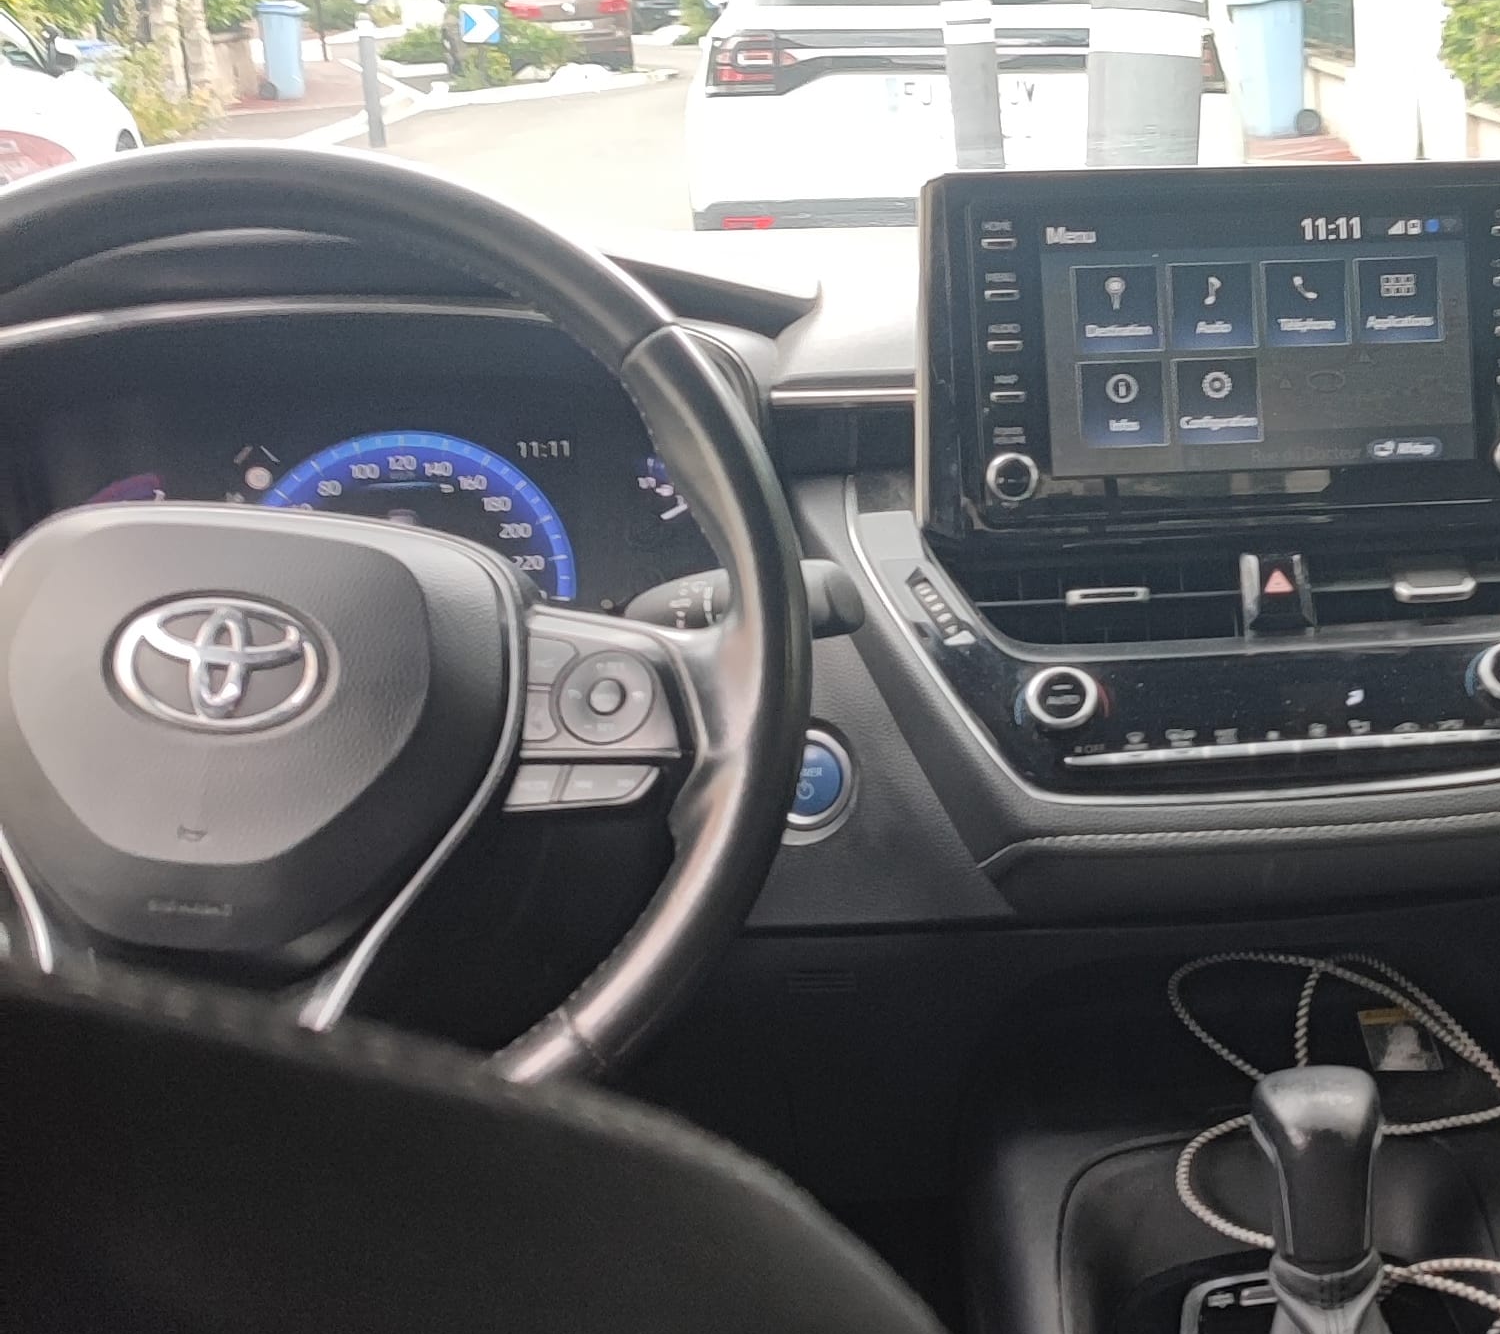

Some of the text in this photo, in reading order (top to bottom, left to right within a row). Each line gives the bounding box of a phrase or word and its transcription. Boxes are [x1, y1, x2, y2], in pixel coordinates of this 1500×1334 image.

[1301, 217, 1361, 240] 11:11
[517, 441, 570, 458] 11:11
[387, 455, 417, 470] 120
[350, 464, 380, 479] 100
[499, 523, 532, 538] 200
